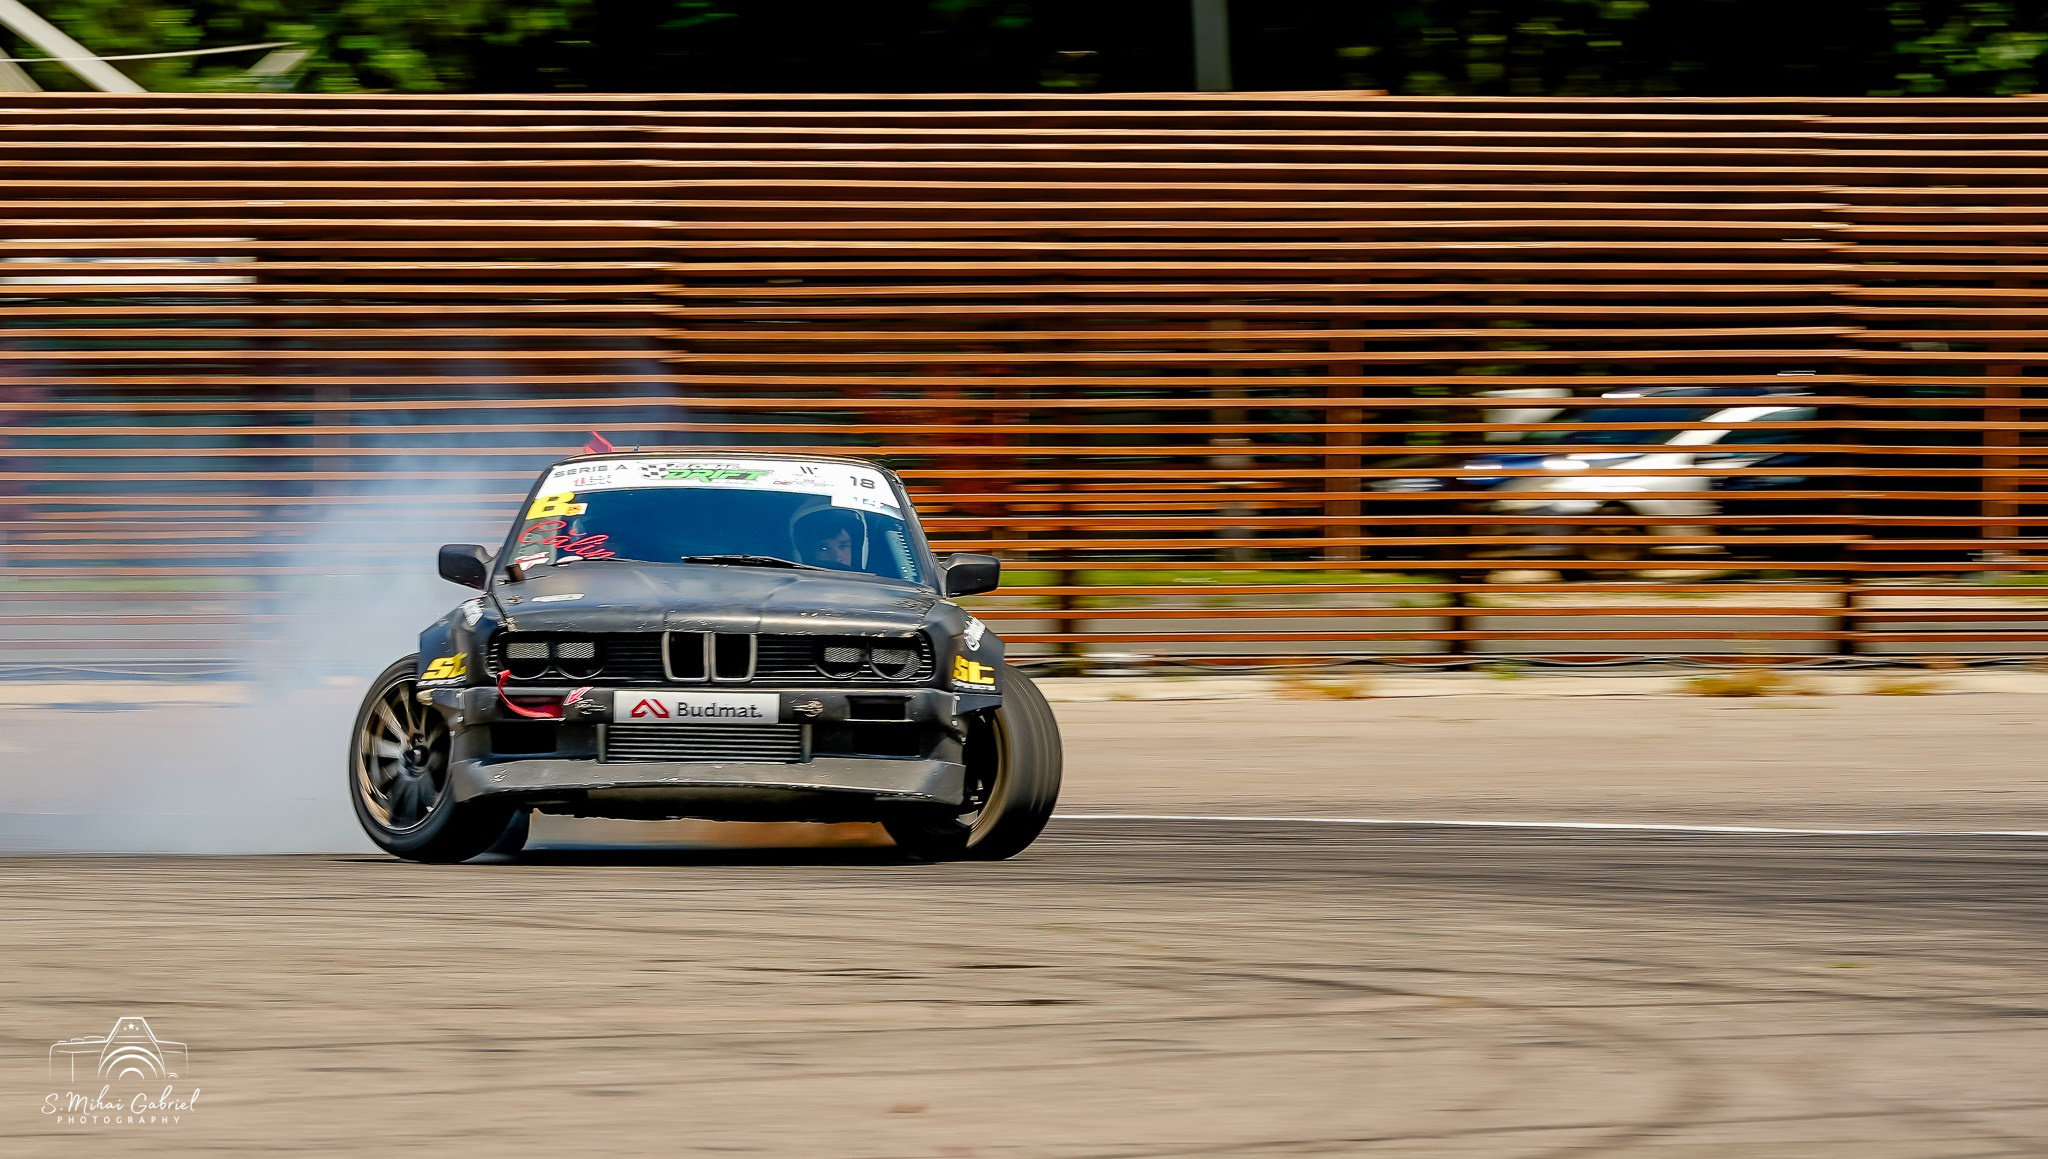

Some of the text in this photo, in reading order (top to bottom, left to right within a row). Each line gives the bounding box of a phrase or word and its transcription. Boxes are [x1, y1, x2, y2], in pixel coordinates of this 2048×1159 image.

[553, 465, 609, 479] SERIE
[660, 468, 770, 484] DRIFT
[849, 475, 876, 490] 18
[525, 491, 575, 521] B
[676, 701, 764, 719] Budmat.
